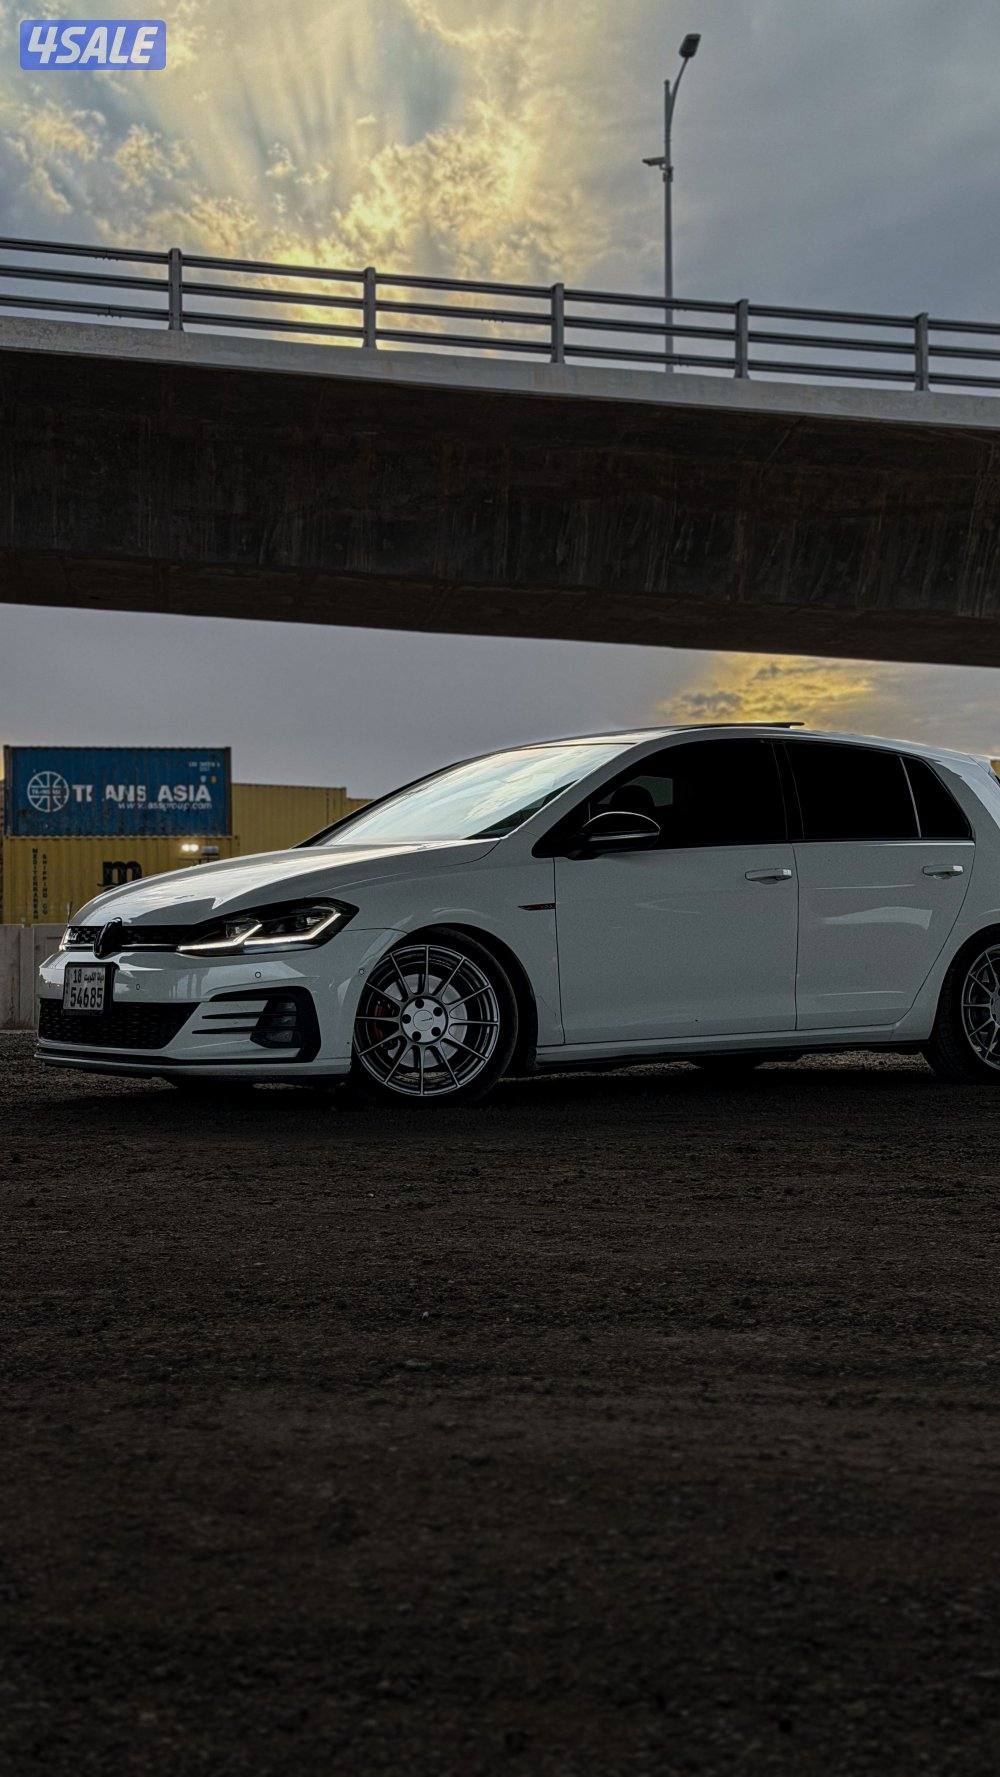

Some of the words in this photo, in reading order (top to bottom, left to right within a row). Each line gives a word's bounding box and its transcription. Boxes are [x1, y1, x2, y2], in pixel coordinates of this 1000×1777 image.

[157, 784, 211, 802] ASIA
[73, 968, 82, 983] 18
[70, 986, 104, 1008] 54685
